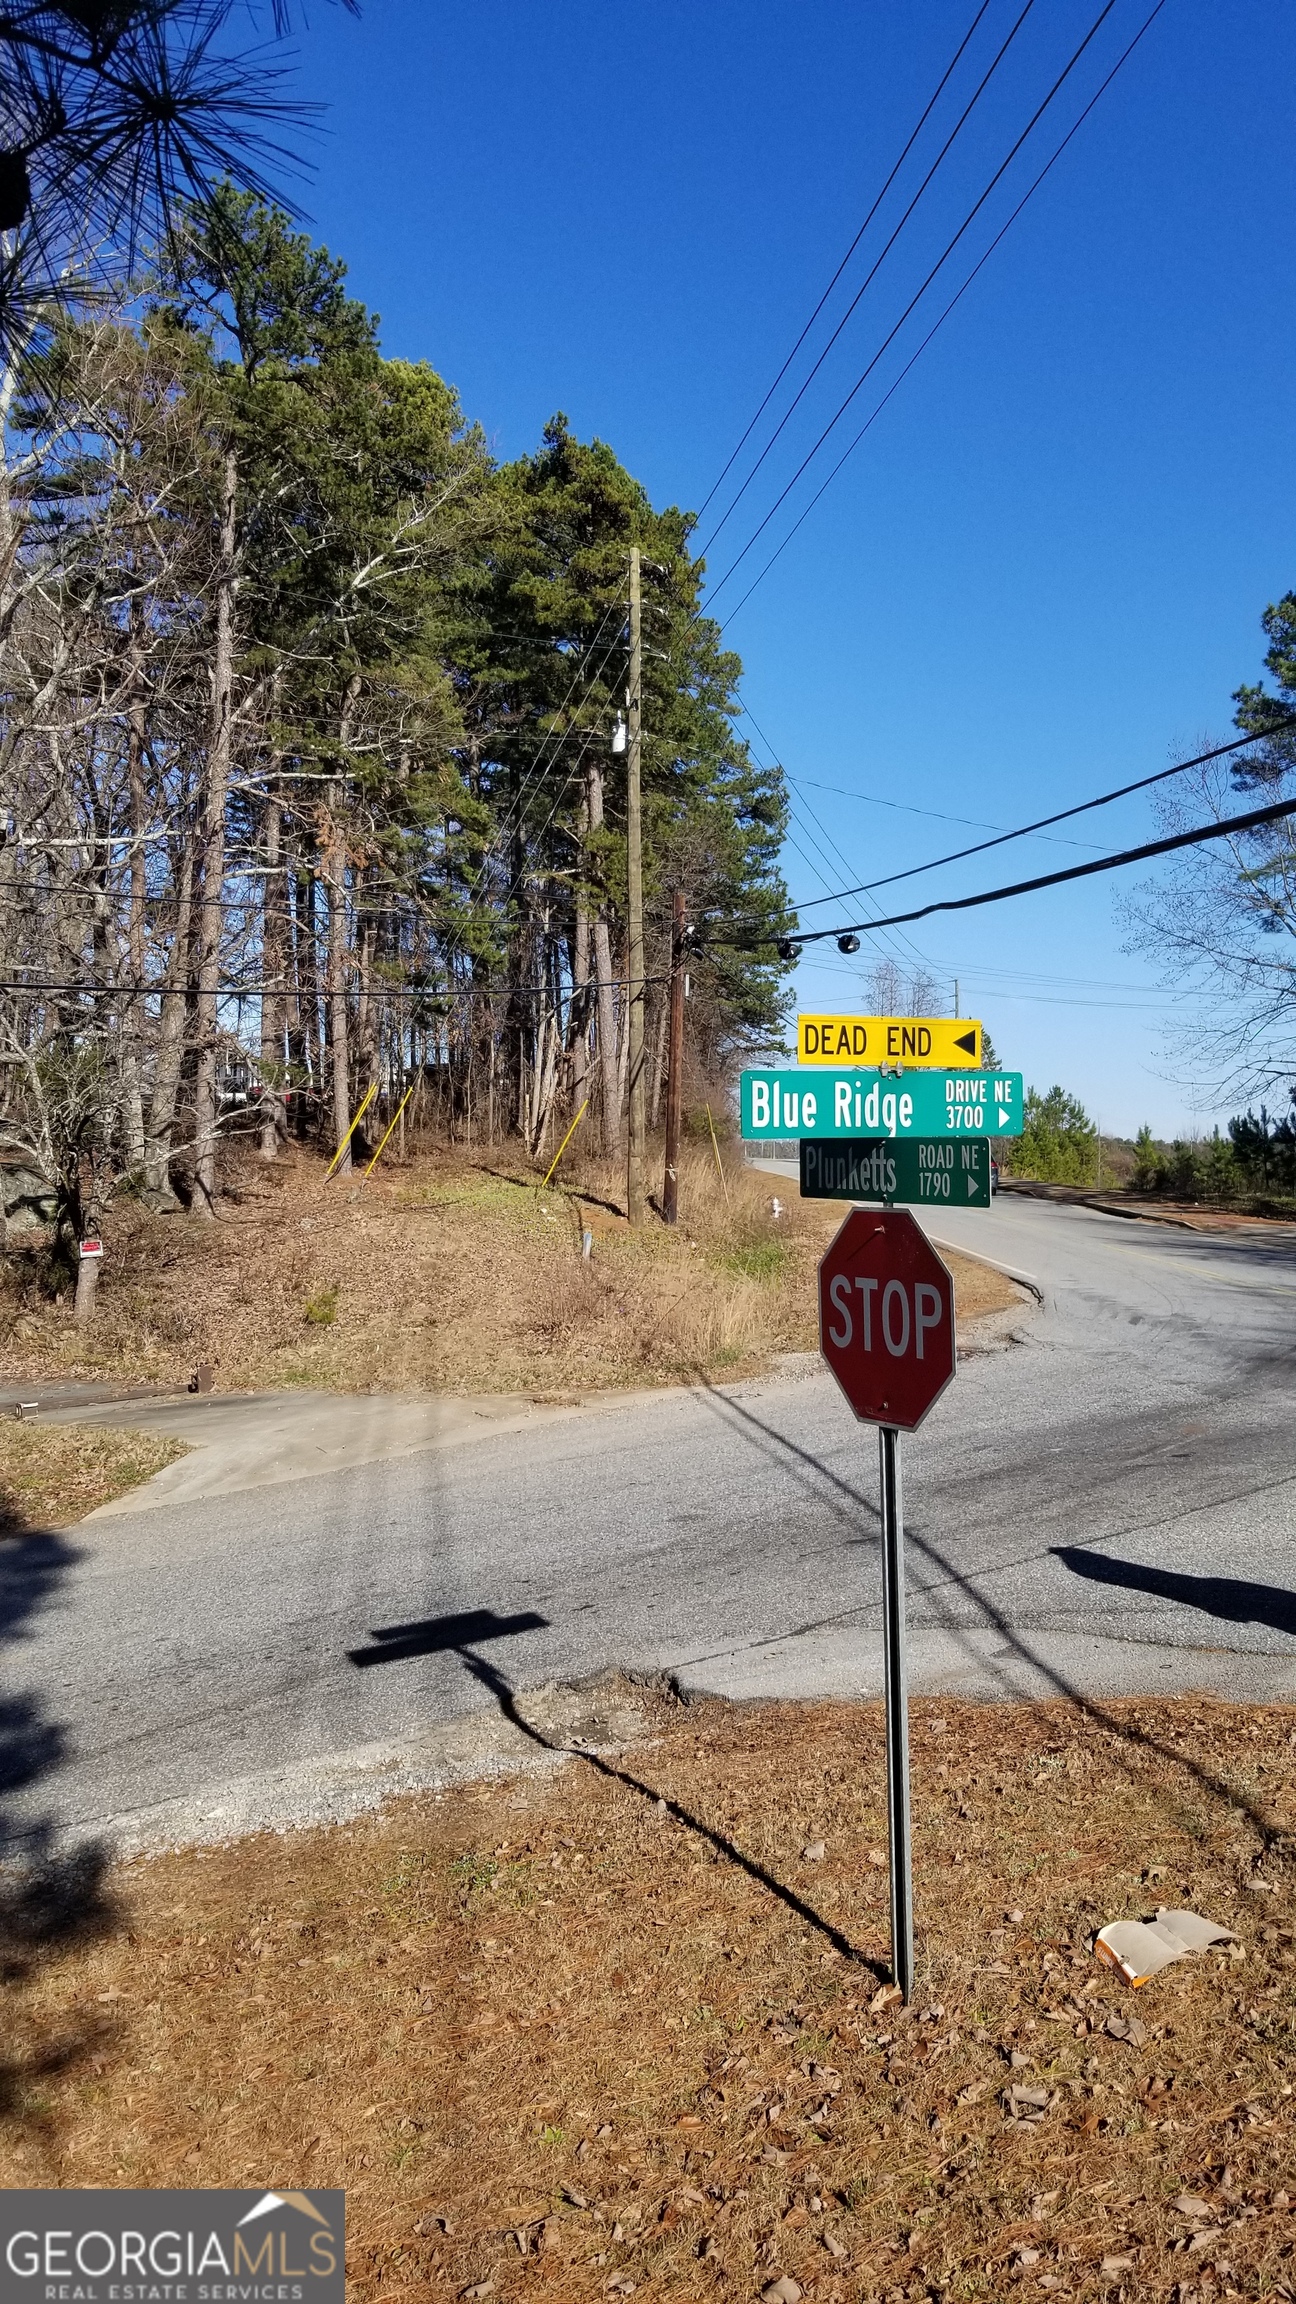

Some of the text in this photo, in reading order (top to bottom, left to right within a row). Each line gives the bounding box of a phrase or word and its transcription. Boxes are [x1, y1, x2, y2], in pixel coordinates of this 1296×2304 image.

[804, 1024, 932, 1057] DEAD END
[945, 1080, 1013, 1103] DRIVE NE
[752, 1080, 913, 1137] Blue Ridge
[945, 1106, 984, 1129] 3700
[805, 1146, 897, 1193] Plunketts
[918, 1145, 980, 1170] ROAD NE
[918, 1173, 951, 1198] 1790
[829, 1274, 942, 1360] STOP
